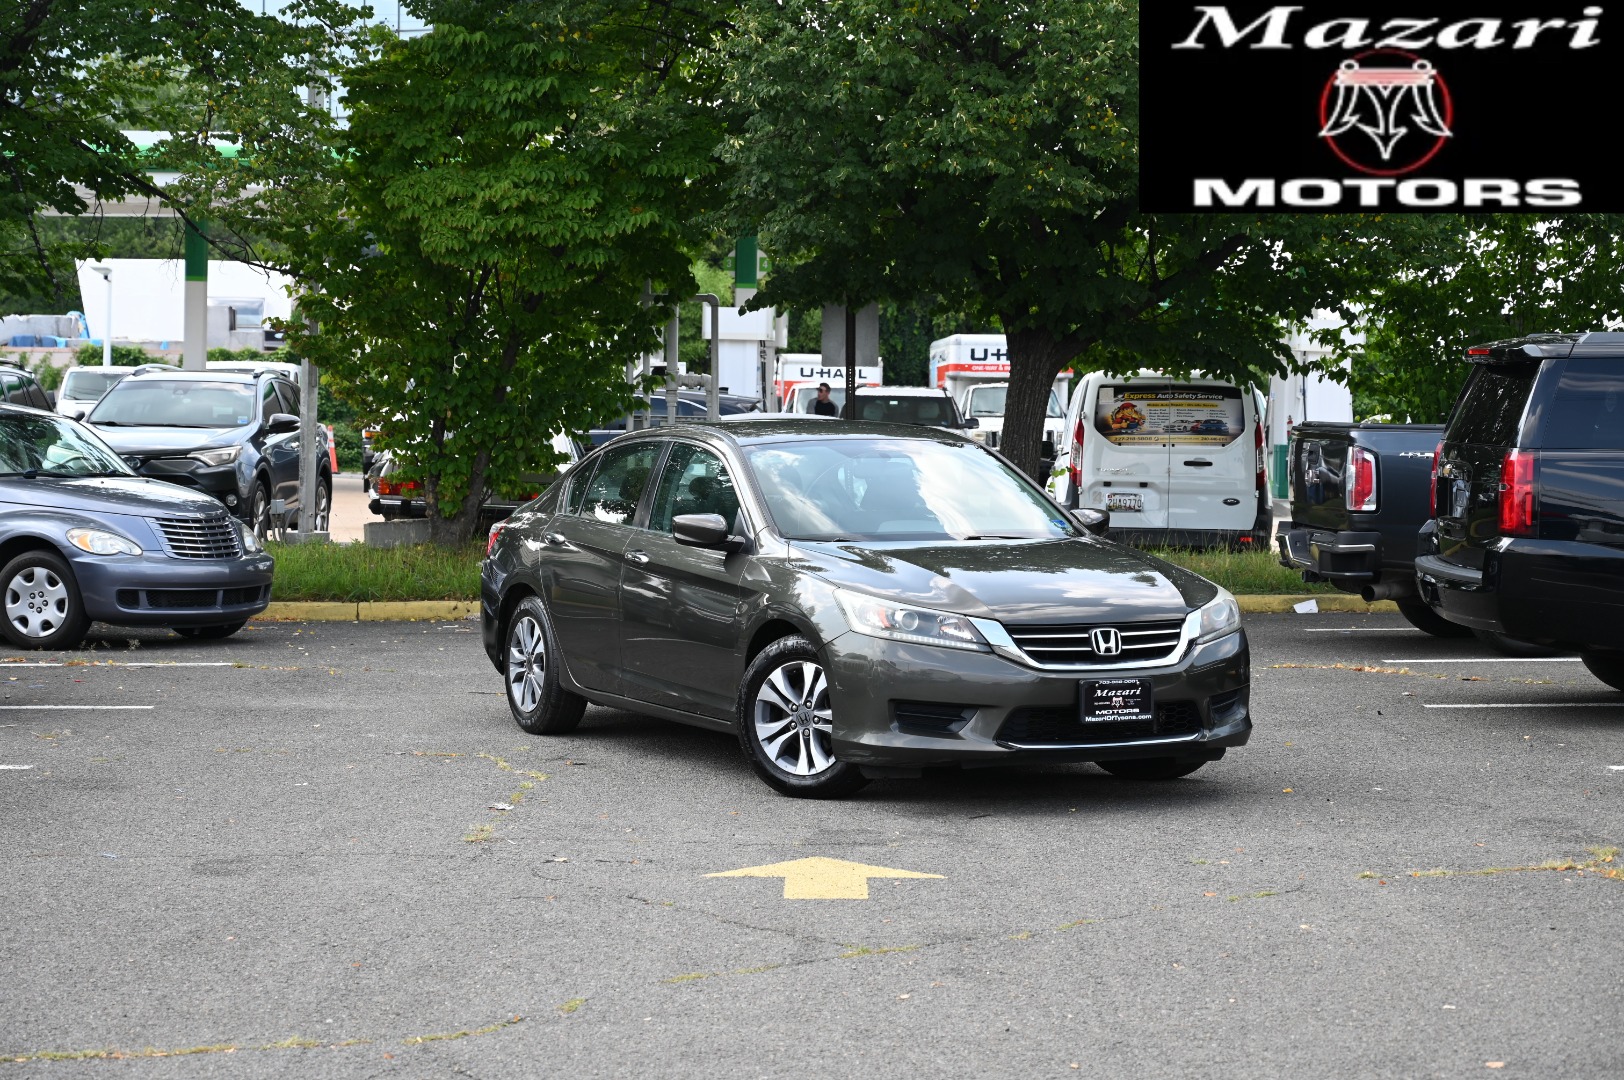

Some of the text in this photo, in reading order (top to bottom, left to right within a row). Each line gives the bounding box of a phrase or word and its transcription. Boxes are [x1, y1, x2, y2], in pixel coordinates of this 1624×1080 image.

[727, 260, 732, 268] 3
[762, 261, 768, 269] 4
[800, 367, 867, 379] U-HAL
[1093, 687, 1141, 697] Mazari
